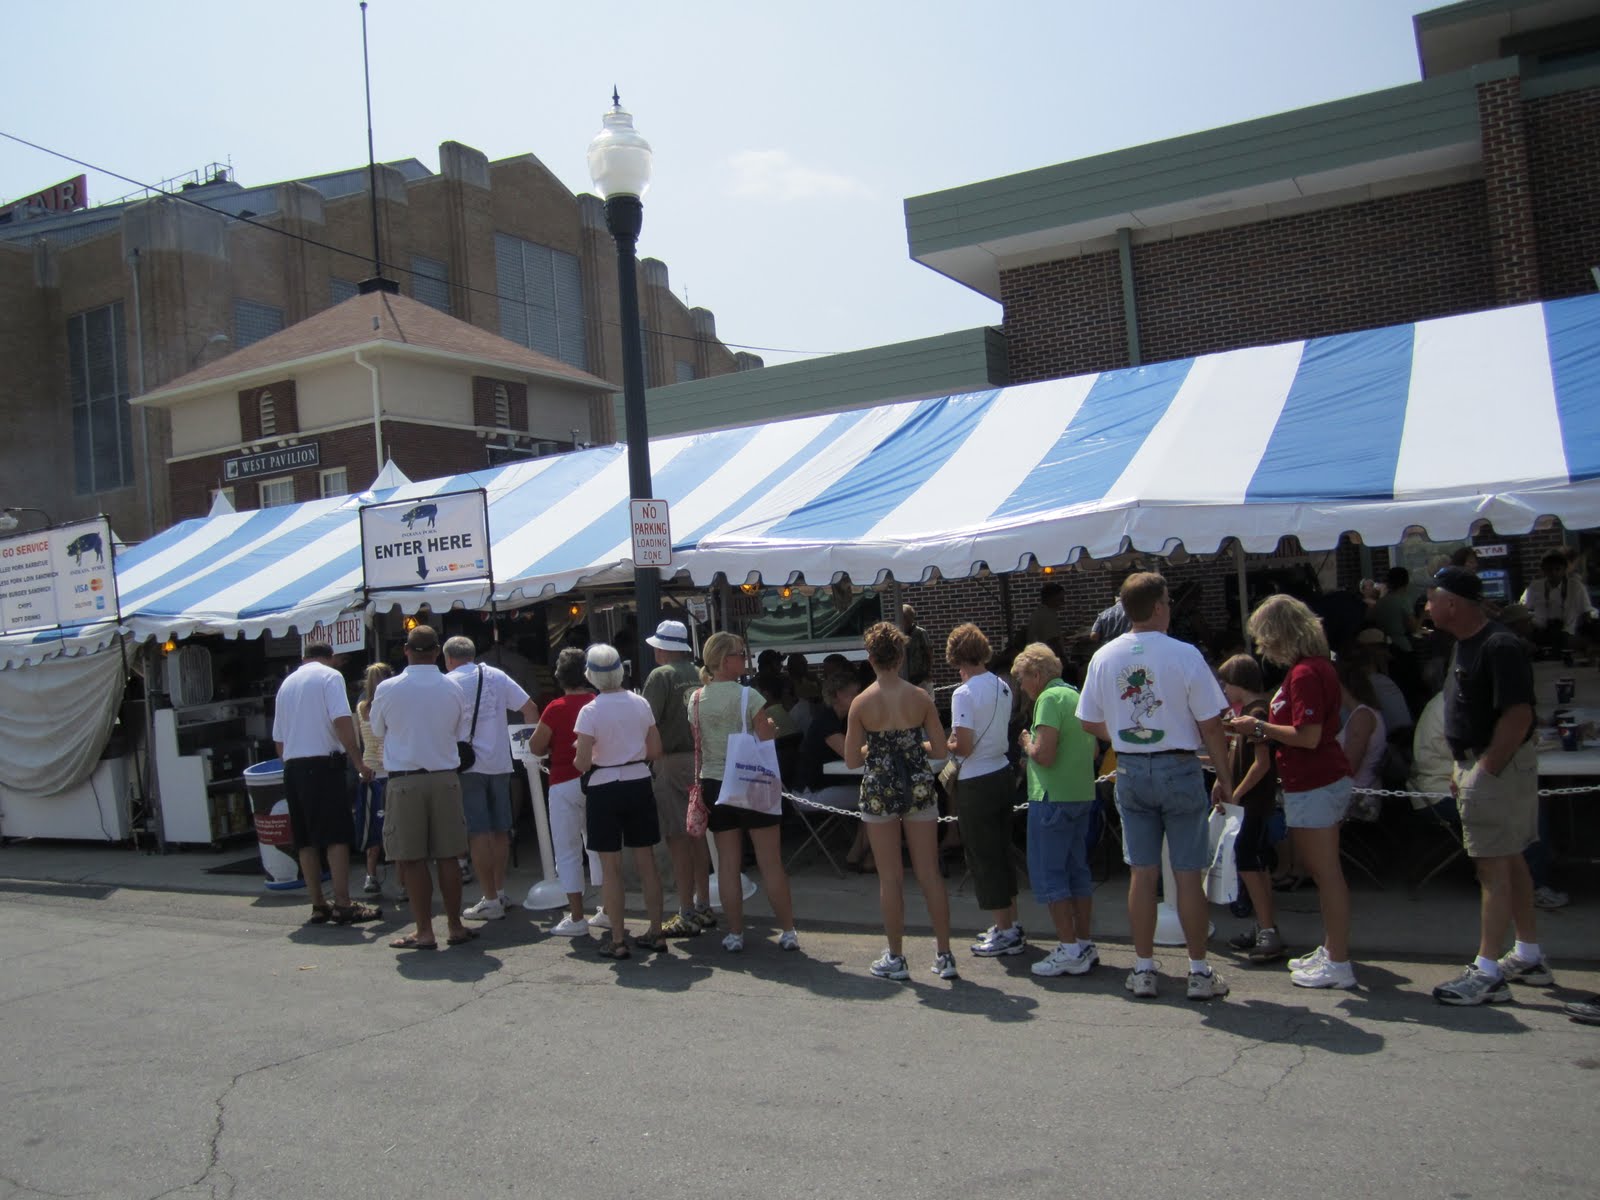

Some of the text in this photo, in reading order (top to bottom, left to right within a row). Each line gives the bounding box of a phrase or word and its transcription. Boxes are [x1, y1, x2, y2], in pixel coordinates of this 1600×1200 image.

[20, 182, 75, 211] AIR
[241, 449, 315, 473] WEST PAVILION
[642, 506, 657, 519] NO
[634, 522, 667, 535] PARKING
[375, 533, 473, 560] ENTER HERE
[637, 538, 667, 548] LOADING
[2, 541, 49, 558] GO SERVICE
[1475, 546, 1504, 555] ATM
[643, 551, 662, 560] ZONE
[12, 563, 24, 571] PORK
[10, 577, 23, 585] PORK
[23, 575, 35, 583] LOIN
[35, 571, 59, 581] SANDWICH
[28, 586, 52, 595] SANDWICH
[74, 584, 89, 593] VISA
[18, 602, 33, 610] CHIPS
[11, 614, 42, 623] SOFT DRINKS
[336, 618, 361, 645] HERE
